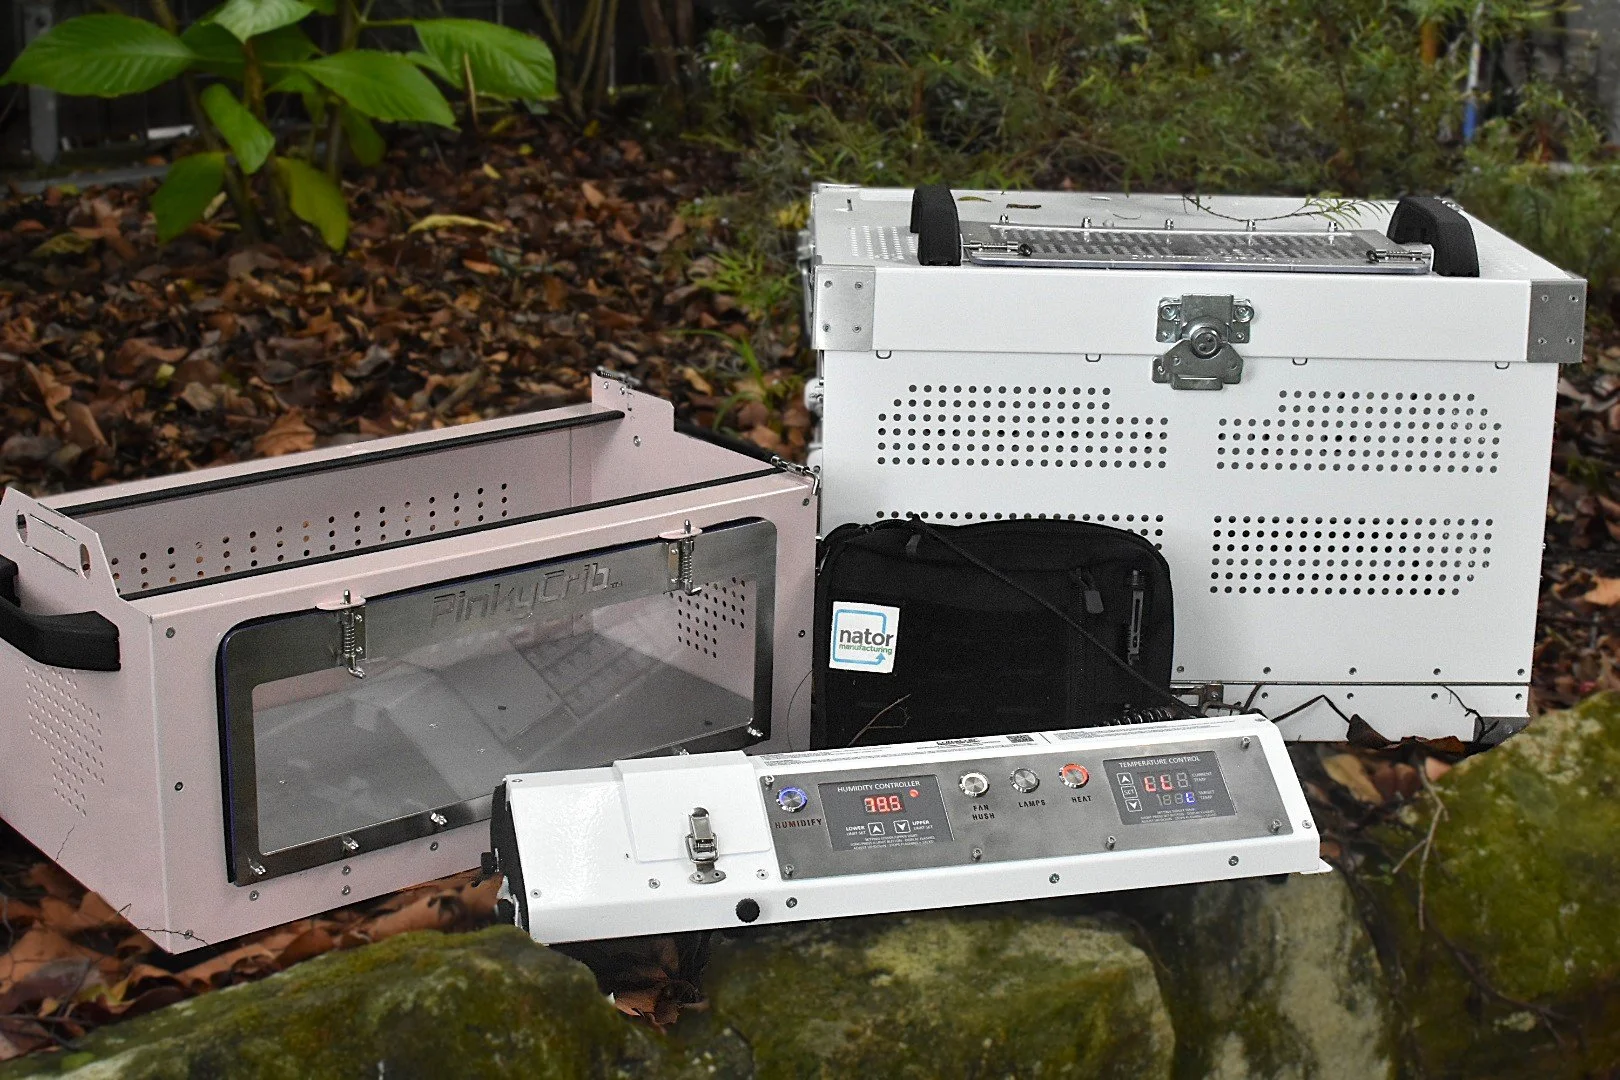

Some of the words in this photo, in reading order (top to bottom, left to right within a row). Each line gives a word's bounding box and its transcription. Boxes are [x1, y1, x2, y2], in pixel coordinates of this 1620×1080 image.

[839, 628, 894, 646] nator
[838, 643, 893, 655] manufacturing
[1119, 758, 1167, 768] TEMPERATURE
[1168, 755, 1201, 764] CONTROL
[837, 783, 874, 793] HUMIDITY
[874, 780, 921, 790] CONTROLLER
[1124, 788, 1135, 796] SET
[1018, 799, 1046, 808] LAMPS
[1071, 795, 1092, 804] HEAT
[973, 804, 989, 812] FAN
[972, 812, 995, 821] HUSH
[774, 818, 823, 830] HUMIDIFY
